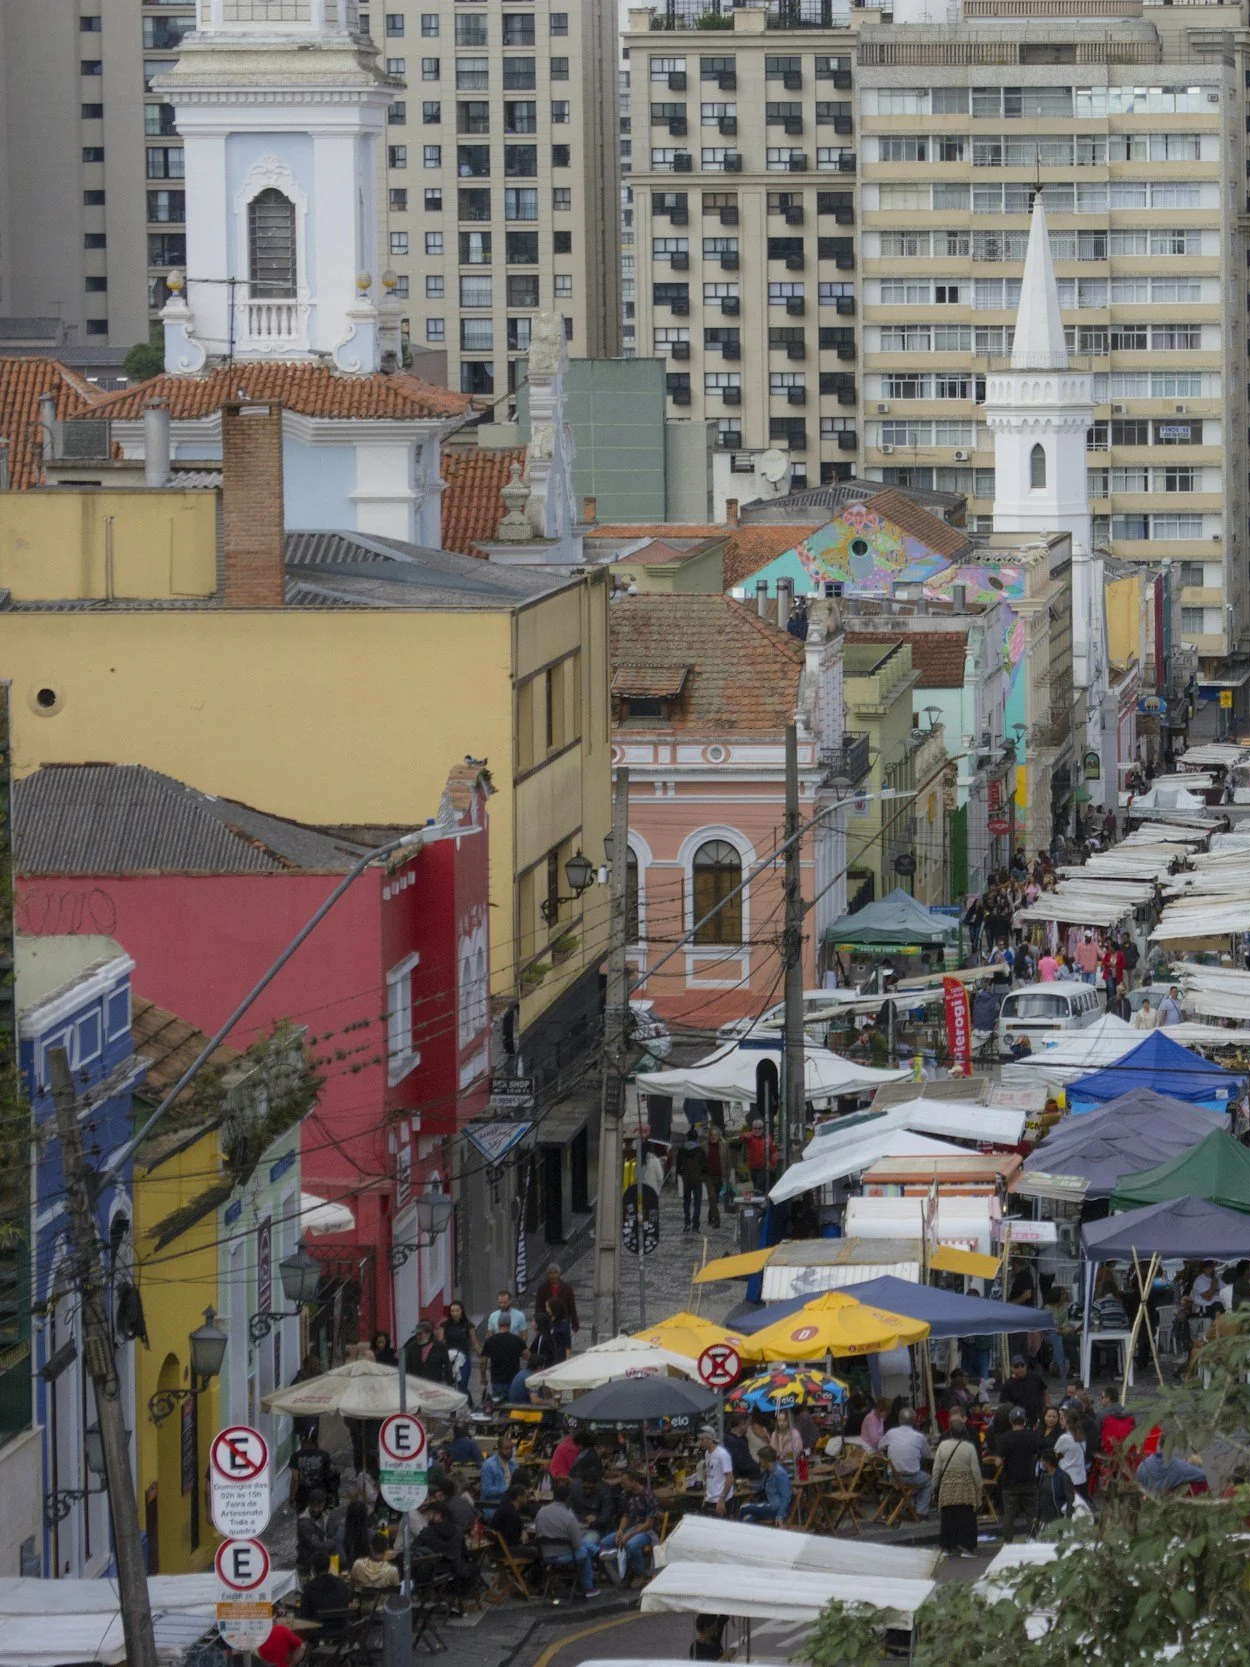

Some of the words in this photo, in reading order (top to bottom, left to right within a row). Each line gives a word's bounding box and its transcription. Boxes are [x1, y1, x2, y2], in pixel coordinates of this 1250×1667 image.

[671, 1416, 689, 1427] elo
[395, 1425, 411, 1450] E
[229, 1438, 250, 1470] E
[214, 1483, 252, 1491] Domingos
[233, 1548, 252, 1579] E
